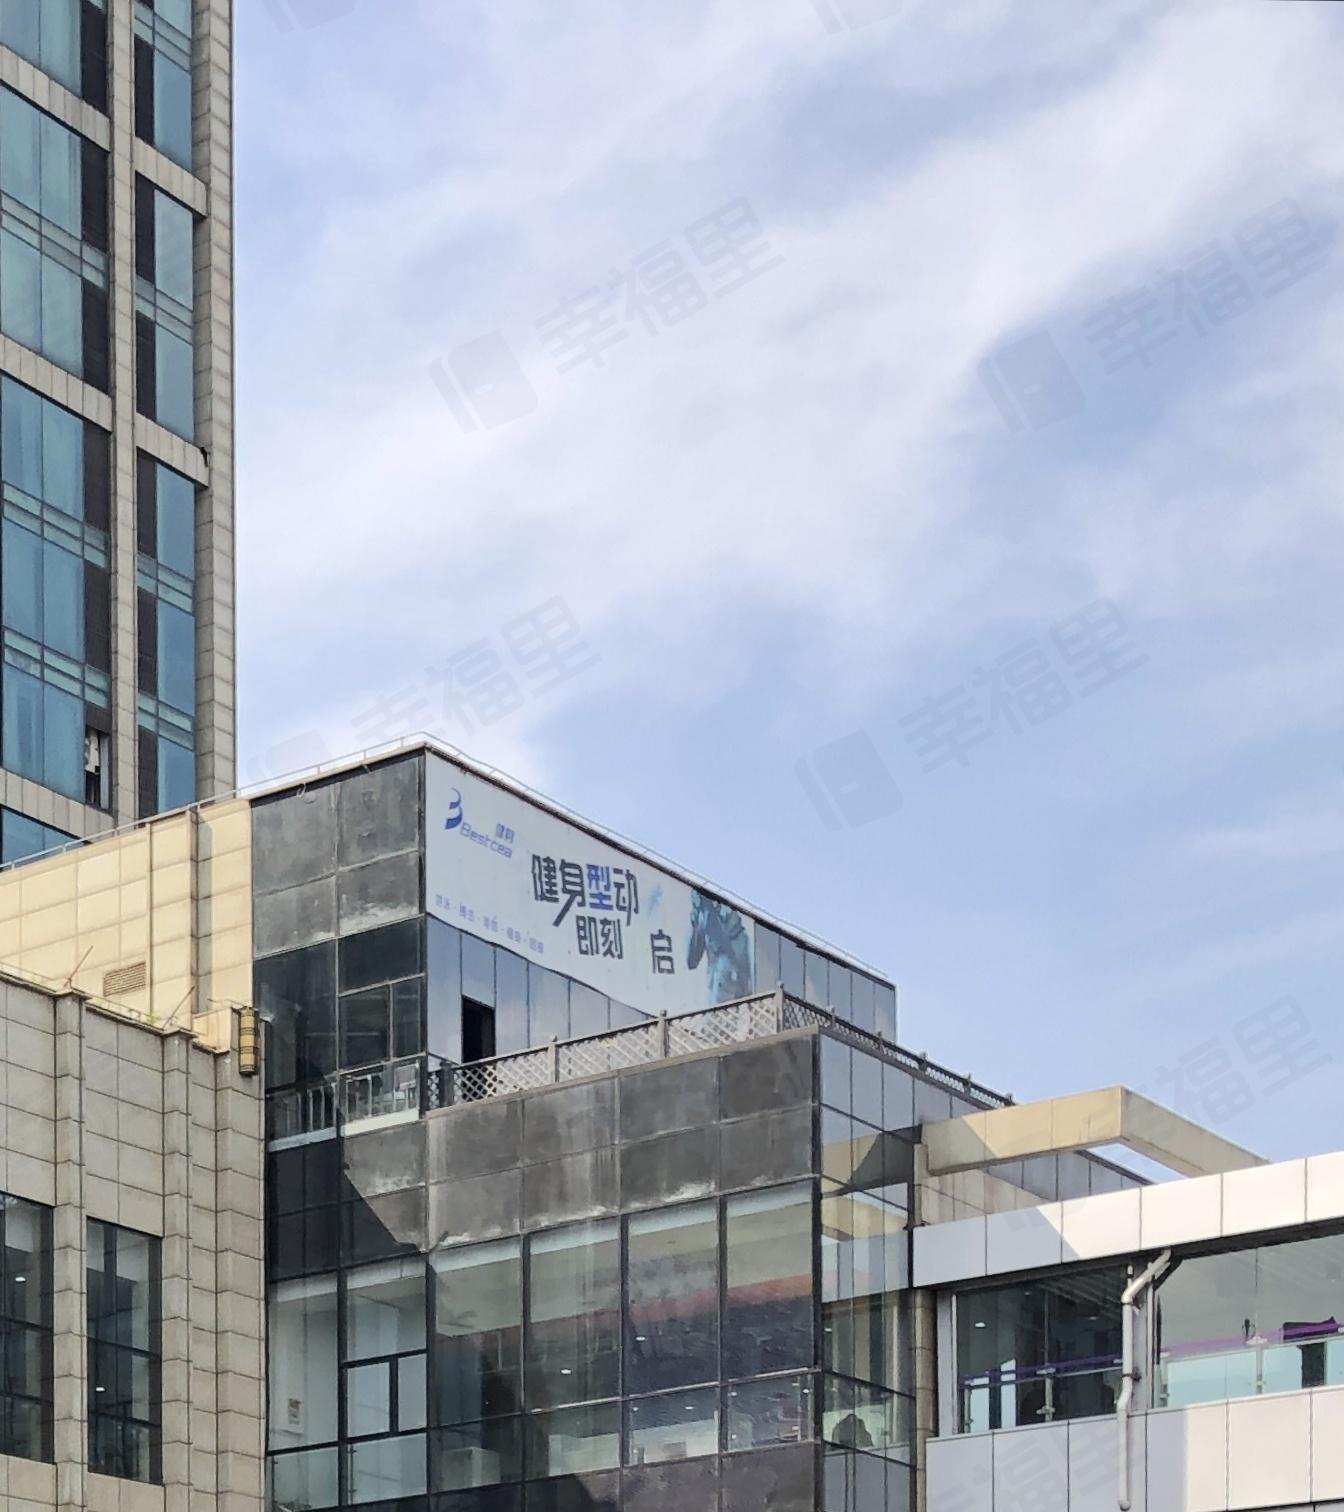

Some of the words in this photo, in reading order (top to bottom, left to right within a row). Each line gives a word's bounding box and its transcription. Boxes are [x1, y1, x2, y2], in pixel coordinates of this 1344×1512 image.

[531, 854, 639, 927] 健身型动
[576, 915, 624, 960] 即刻
[650, 928, 675, 974] 启
